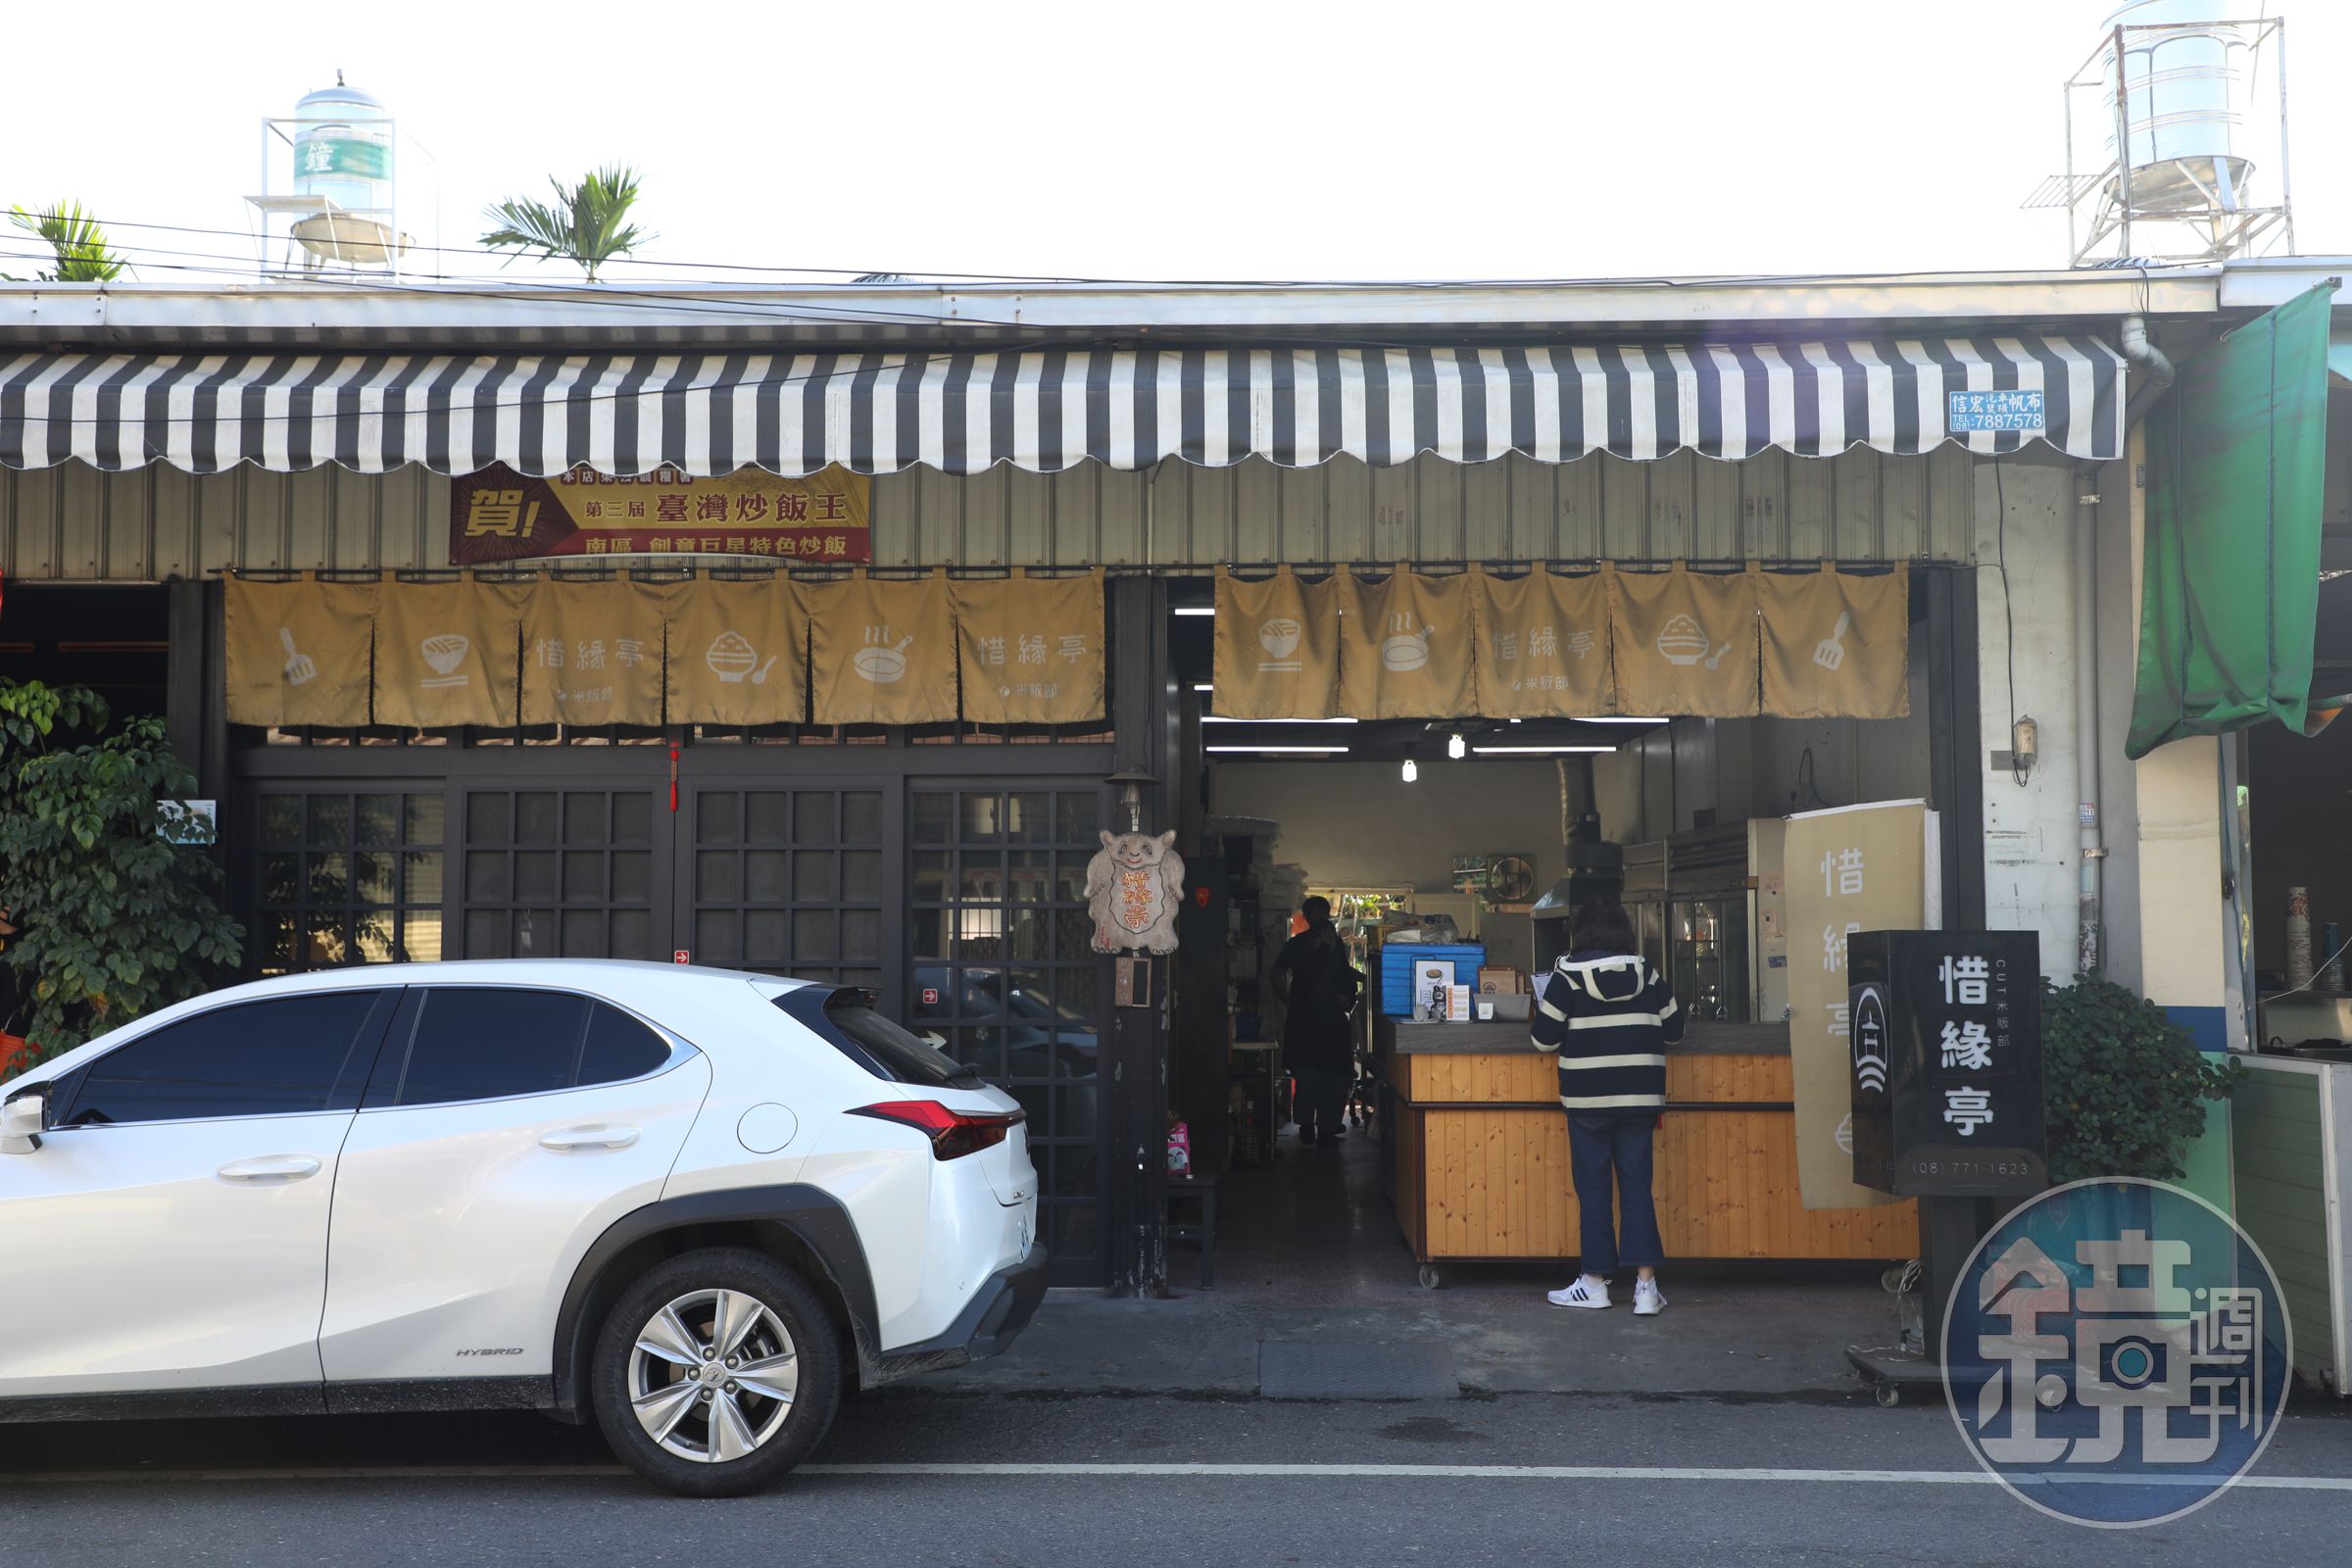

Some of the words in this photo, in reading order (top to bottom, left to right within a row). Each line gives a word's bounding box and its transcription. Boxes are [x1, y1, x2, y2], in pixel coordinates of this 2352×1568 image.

[1952, 394, 1984, 414] 信宏
[2009, 393, 2041, 413] 帆布
[1975, 413, 2042, 428] 7887578
[465, 489, 541, 538] 賀!
[585, 500, 645, 518] 第三屆
[656, 493, 847, 522] 臺灣炒飯王
[585, 537, 632, 554] 南區
[536, 637, 644, 670] 惜緣亭
[977, 634, 1087, 665] 惜緣亭
[1493, 626, 1594, 660] 惜緣亭
[1938, 955, 1993, 1137] 惜緣亭
[1913, 1161, 1944, 1175] (08)
[1952, 1162, 2028, 1175] 771-1623
[456, 1348, 523, 1356] HYBRID
